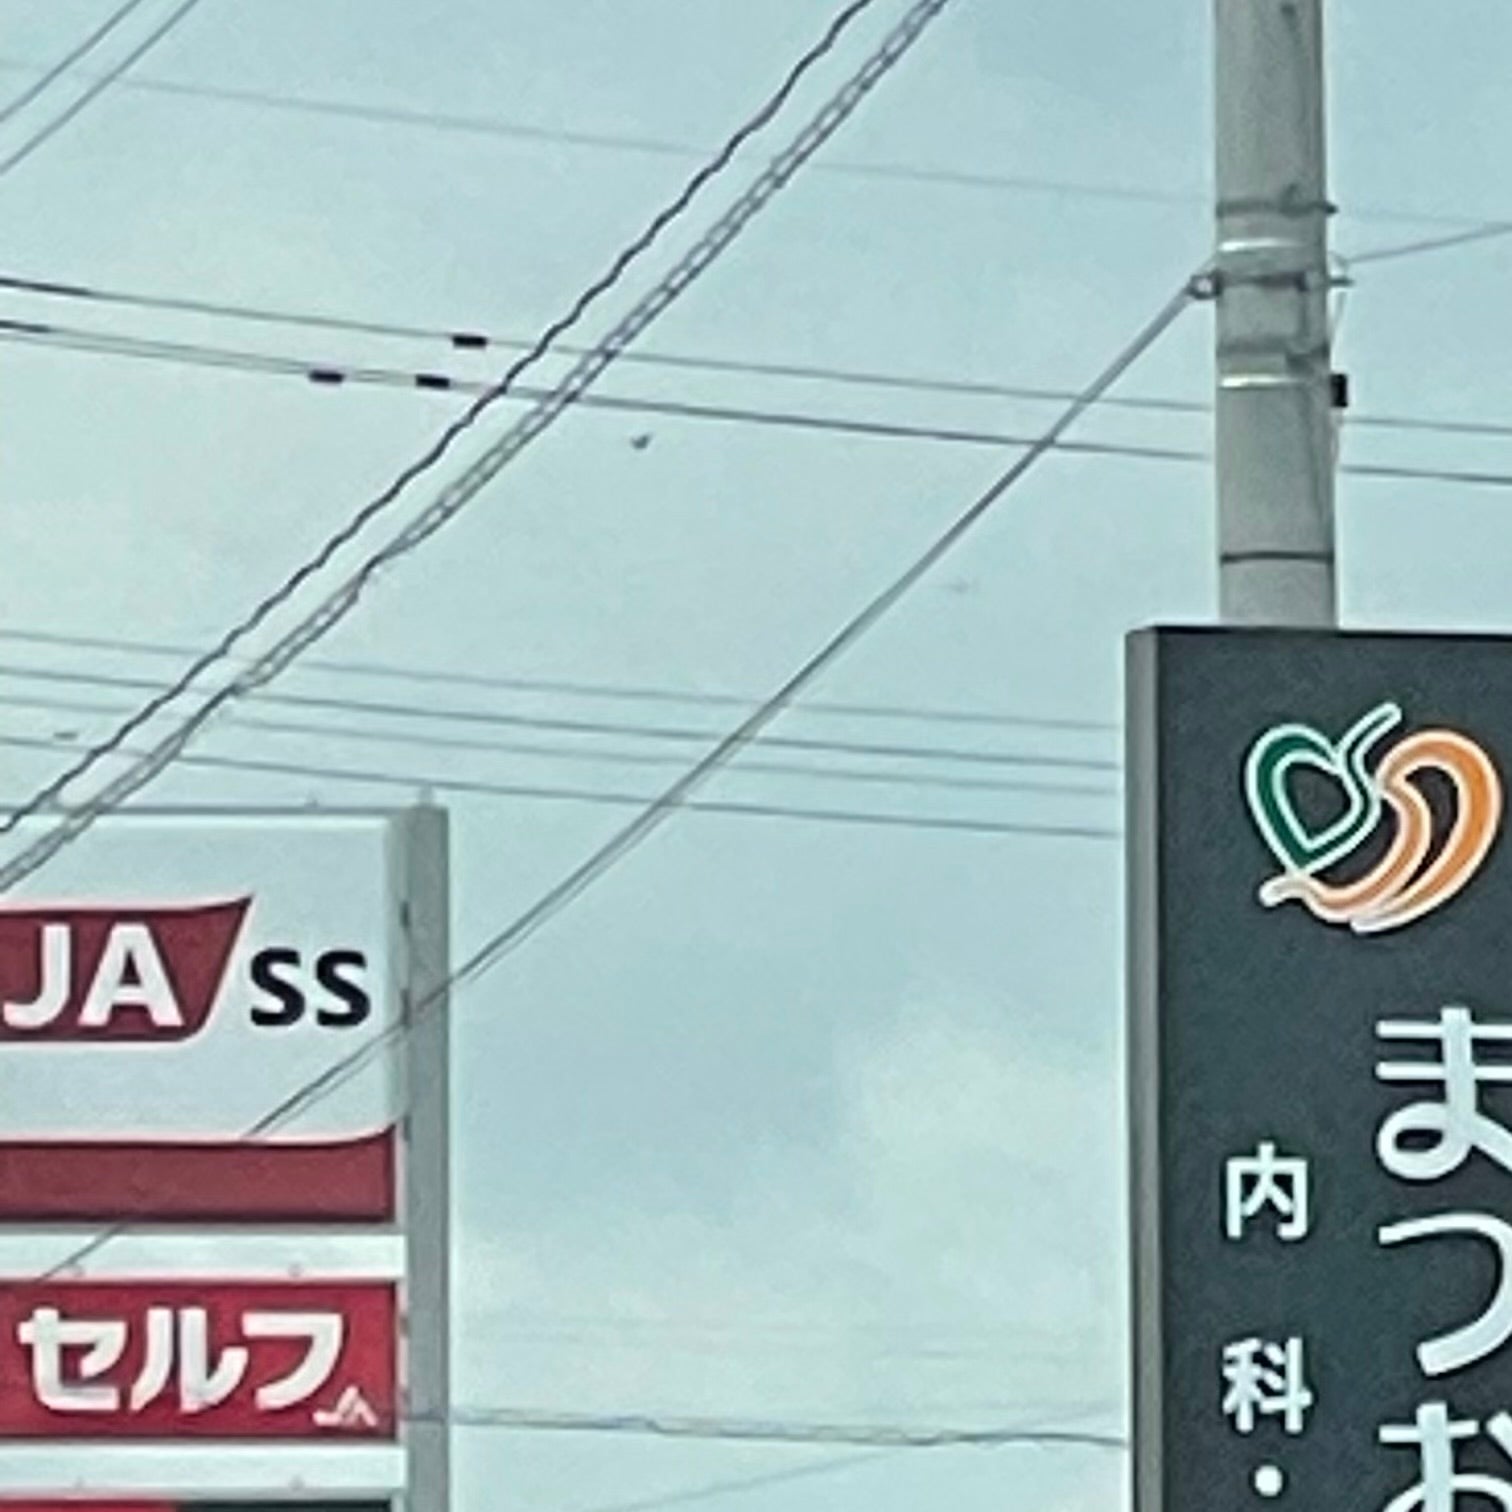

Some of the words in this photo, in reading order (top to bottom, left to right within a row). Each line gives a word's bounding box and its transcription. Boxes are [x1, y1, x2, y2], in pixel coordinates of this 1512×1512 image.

[2, 922, 184, 1028] JA
[18, 1308, 344, 1413] セルフ
